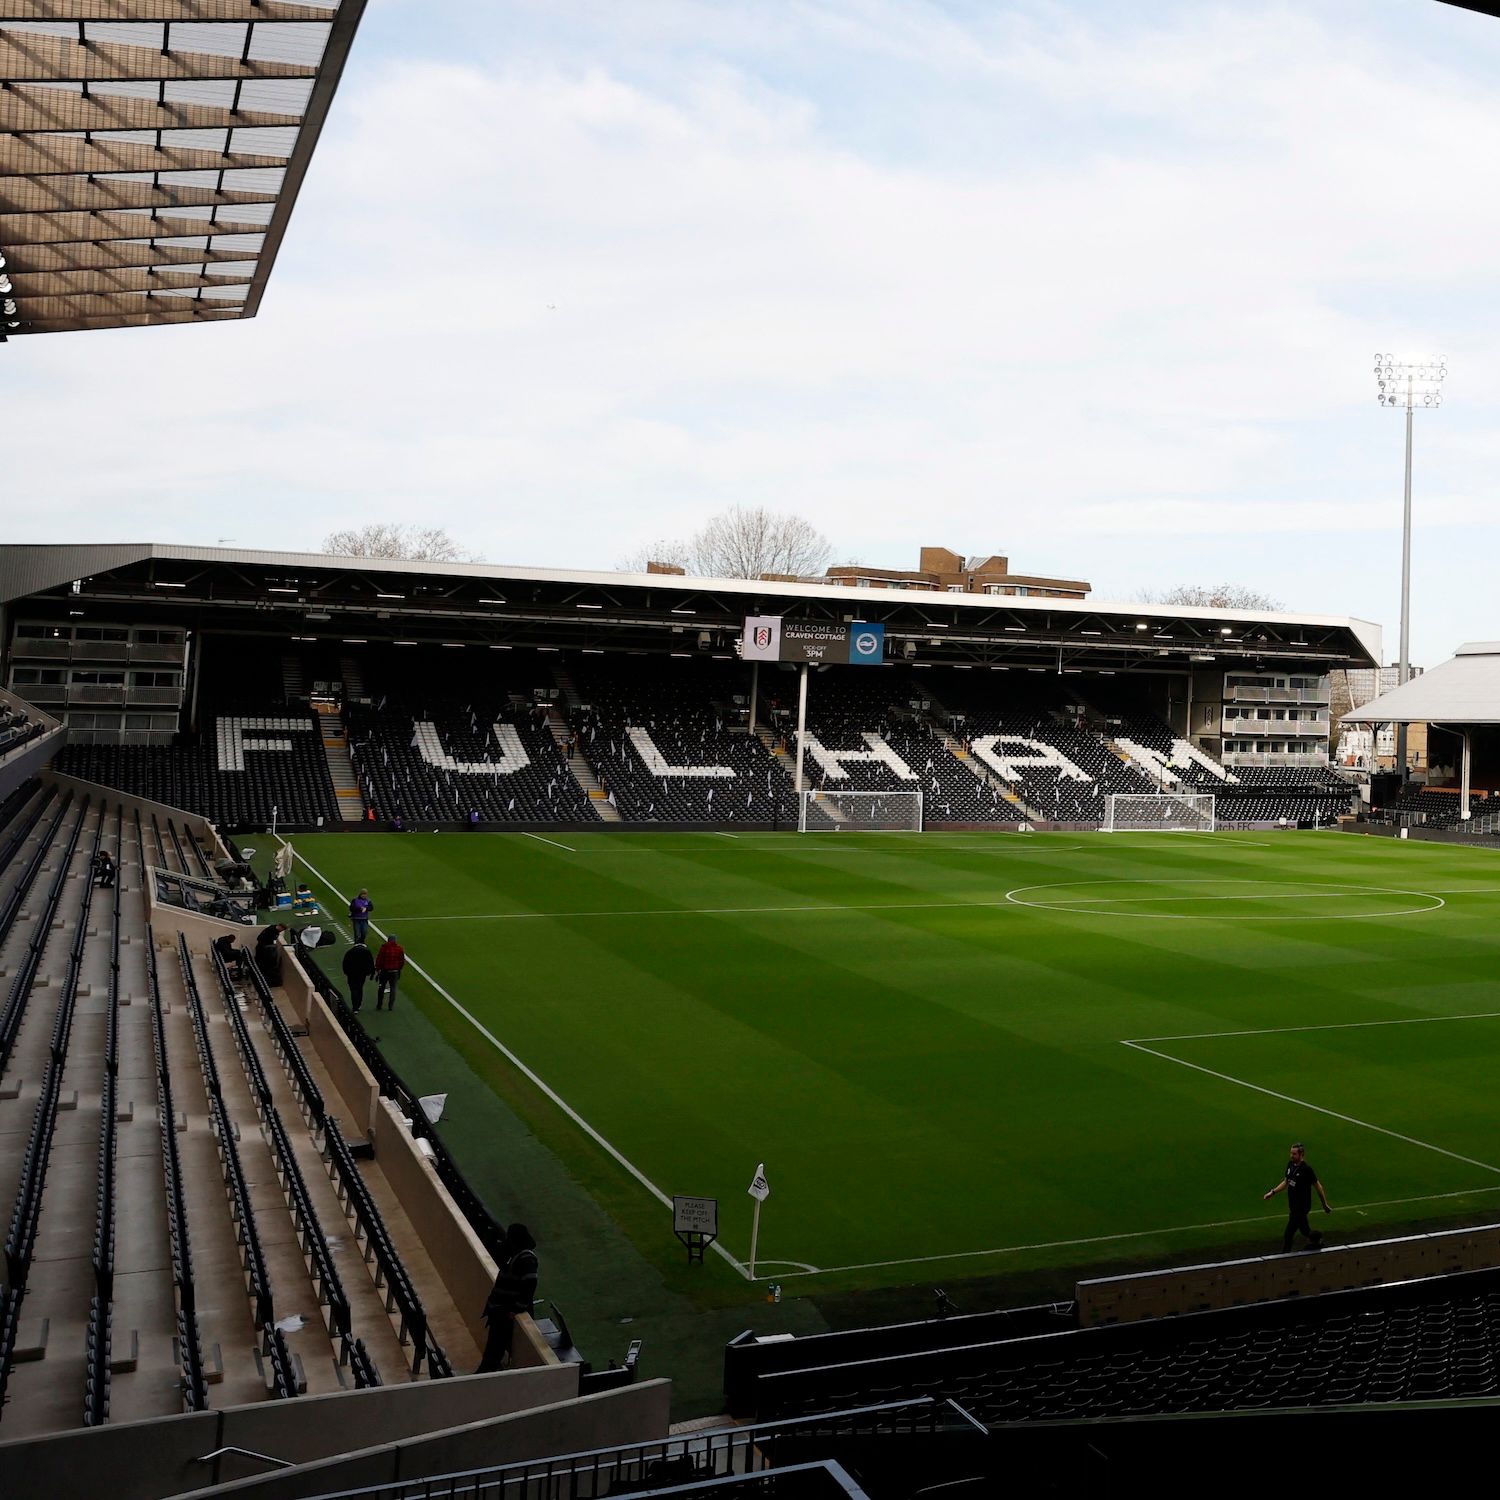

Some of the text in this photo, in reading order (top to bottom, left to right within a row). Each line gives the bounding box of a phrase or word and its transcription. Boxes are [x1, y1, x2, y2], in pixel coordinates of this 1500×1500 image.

[785, 624, 831, 633] WELCOME
[785, 632, 846, 641] CRAVEN COTTAGE
[806, 650, 823, 658] 3PM
[215, 716, 1240, 784] FULHAM
[1237, 822, 1256, 831] FFC
[693, 1216, 710, 1224] PITCH
